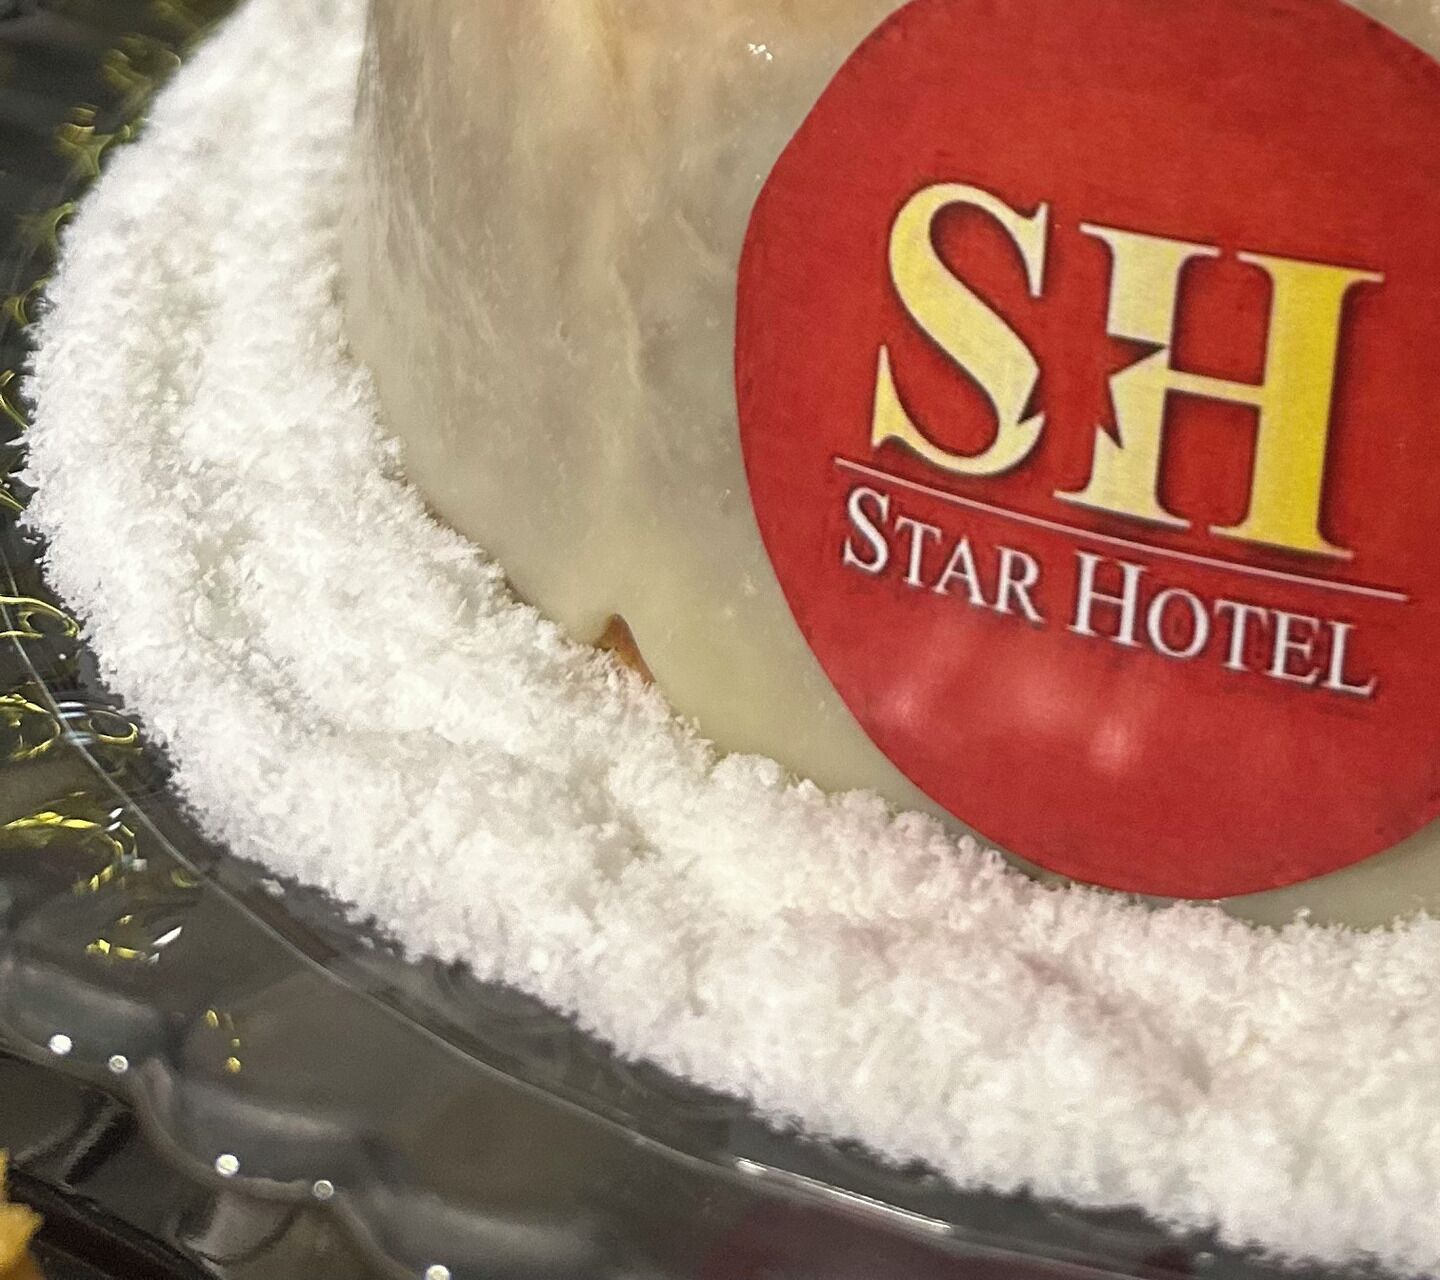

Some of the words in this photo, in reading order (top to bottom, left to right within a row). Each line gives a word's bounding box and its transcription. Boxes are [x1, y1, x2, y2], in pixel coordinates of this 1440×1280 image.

[870, 182, 1386, 561] SH
[842, 485, 1044, 625] STAR
[1067, 550, 1379, 698] HOTEL
